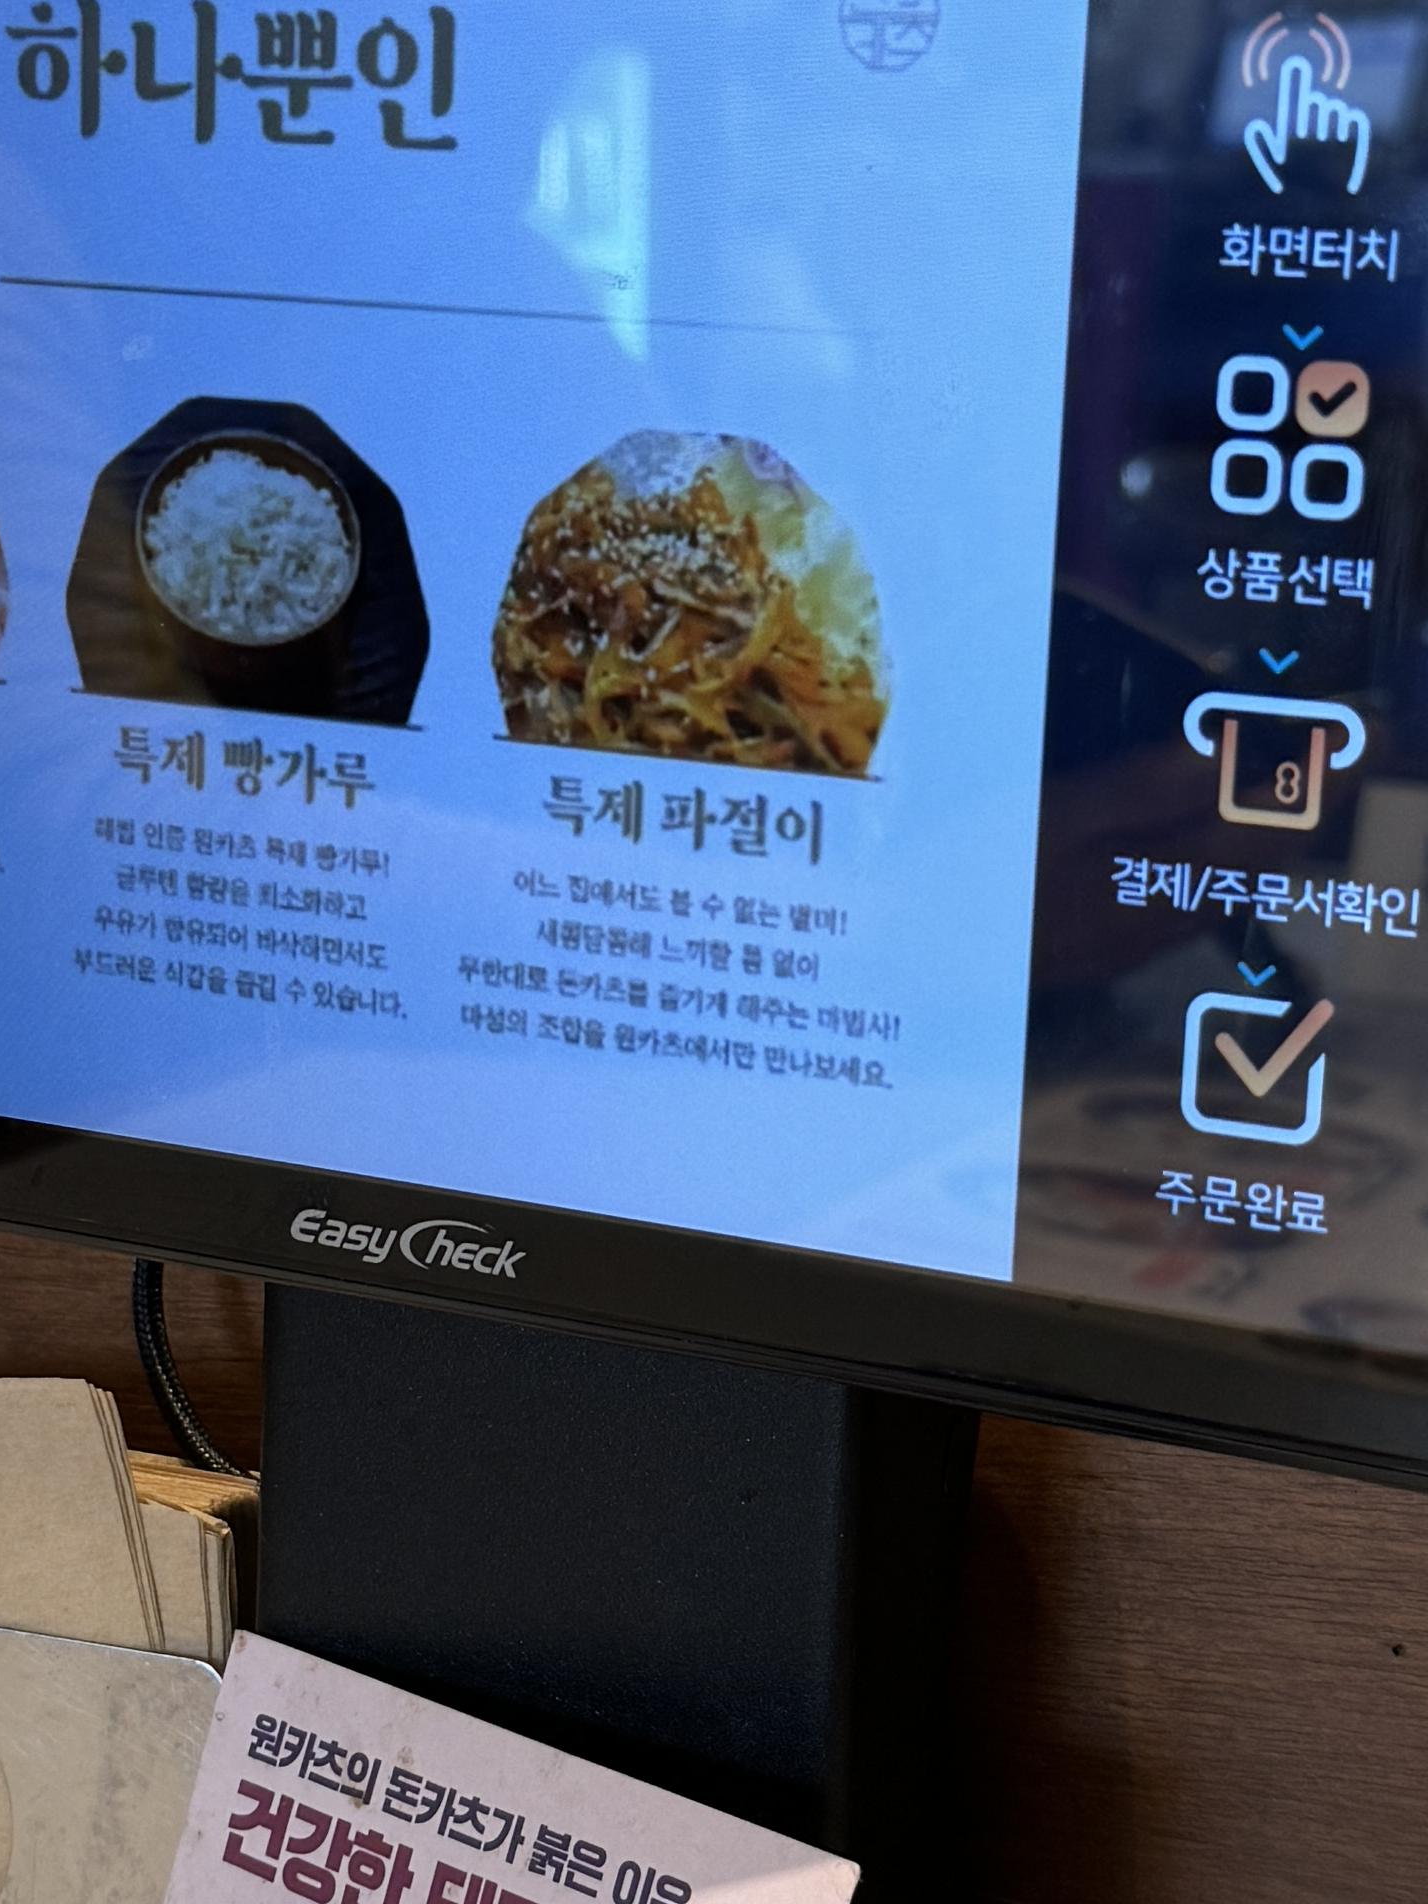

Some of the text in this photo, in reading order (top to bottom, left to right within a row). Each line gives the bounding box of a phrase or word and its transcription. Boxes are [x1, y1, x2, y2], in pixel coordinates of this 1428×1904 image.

[1219, 222, 1399, 283] 화면터치
[1197, 548, 1374, 610] 상품선택
[114, 725, 375, 810] 특제 빵가루
[543, 775, 823, 866] 특제 파절이
[1110, 856, 1421, 939] 결제/주문서확인
[1155, 1169, 1329, 1235] 주문완료
[247, 1712, 381, 1806] 원카츠의
[382, 1764, 525, 1863] 돈카츠가
[527, 1824, 608, 1899] 붉은
